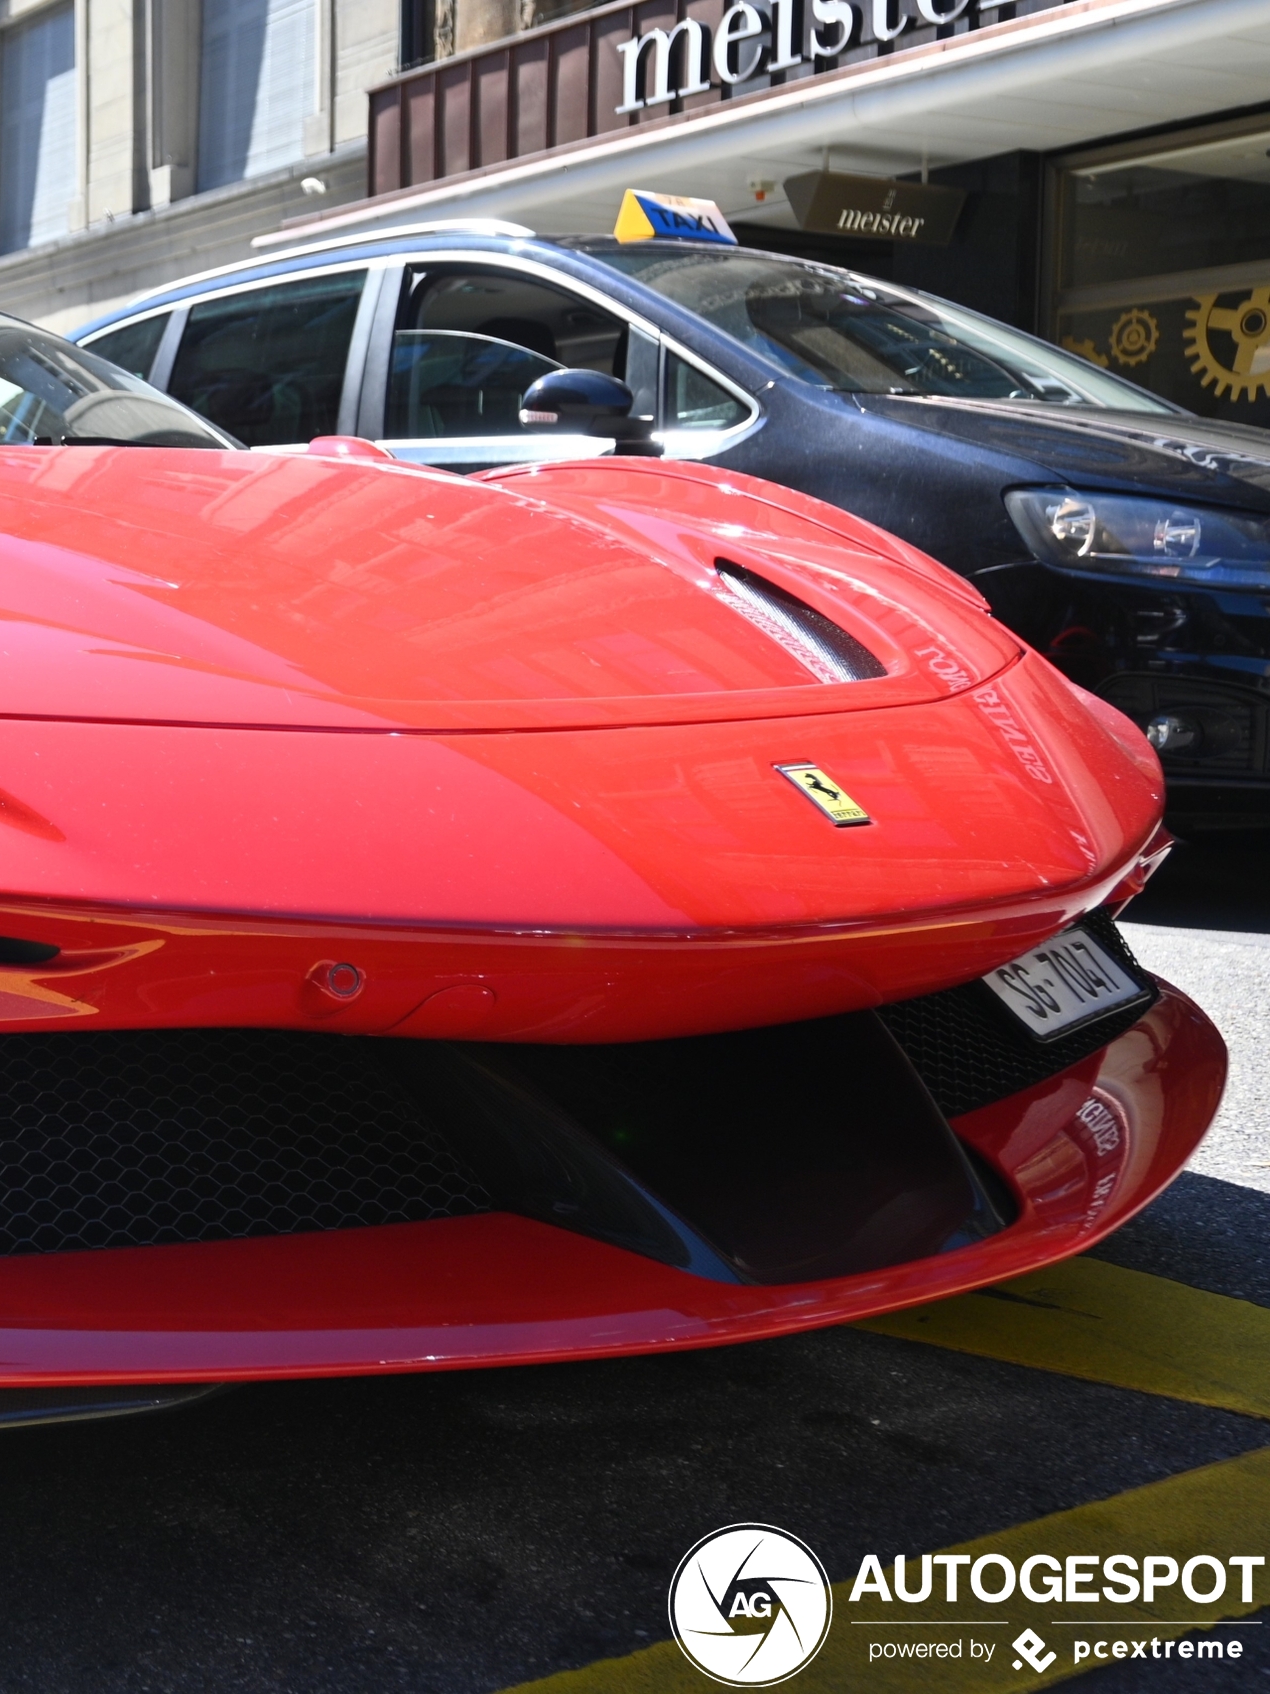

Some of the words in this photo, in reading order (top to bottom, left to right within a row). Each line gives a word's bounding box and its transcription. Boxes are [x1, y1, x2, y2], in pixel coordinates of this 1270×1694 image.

[614, 0, 1018, 114] meist
[650, 207, 720, 234] TAXI
[837, 208, 925, 238] meister
